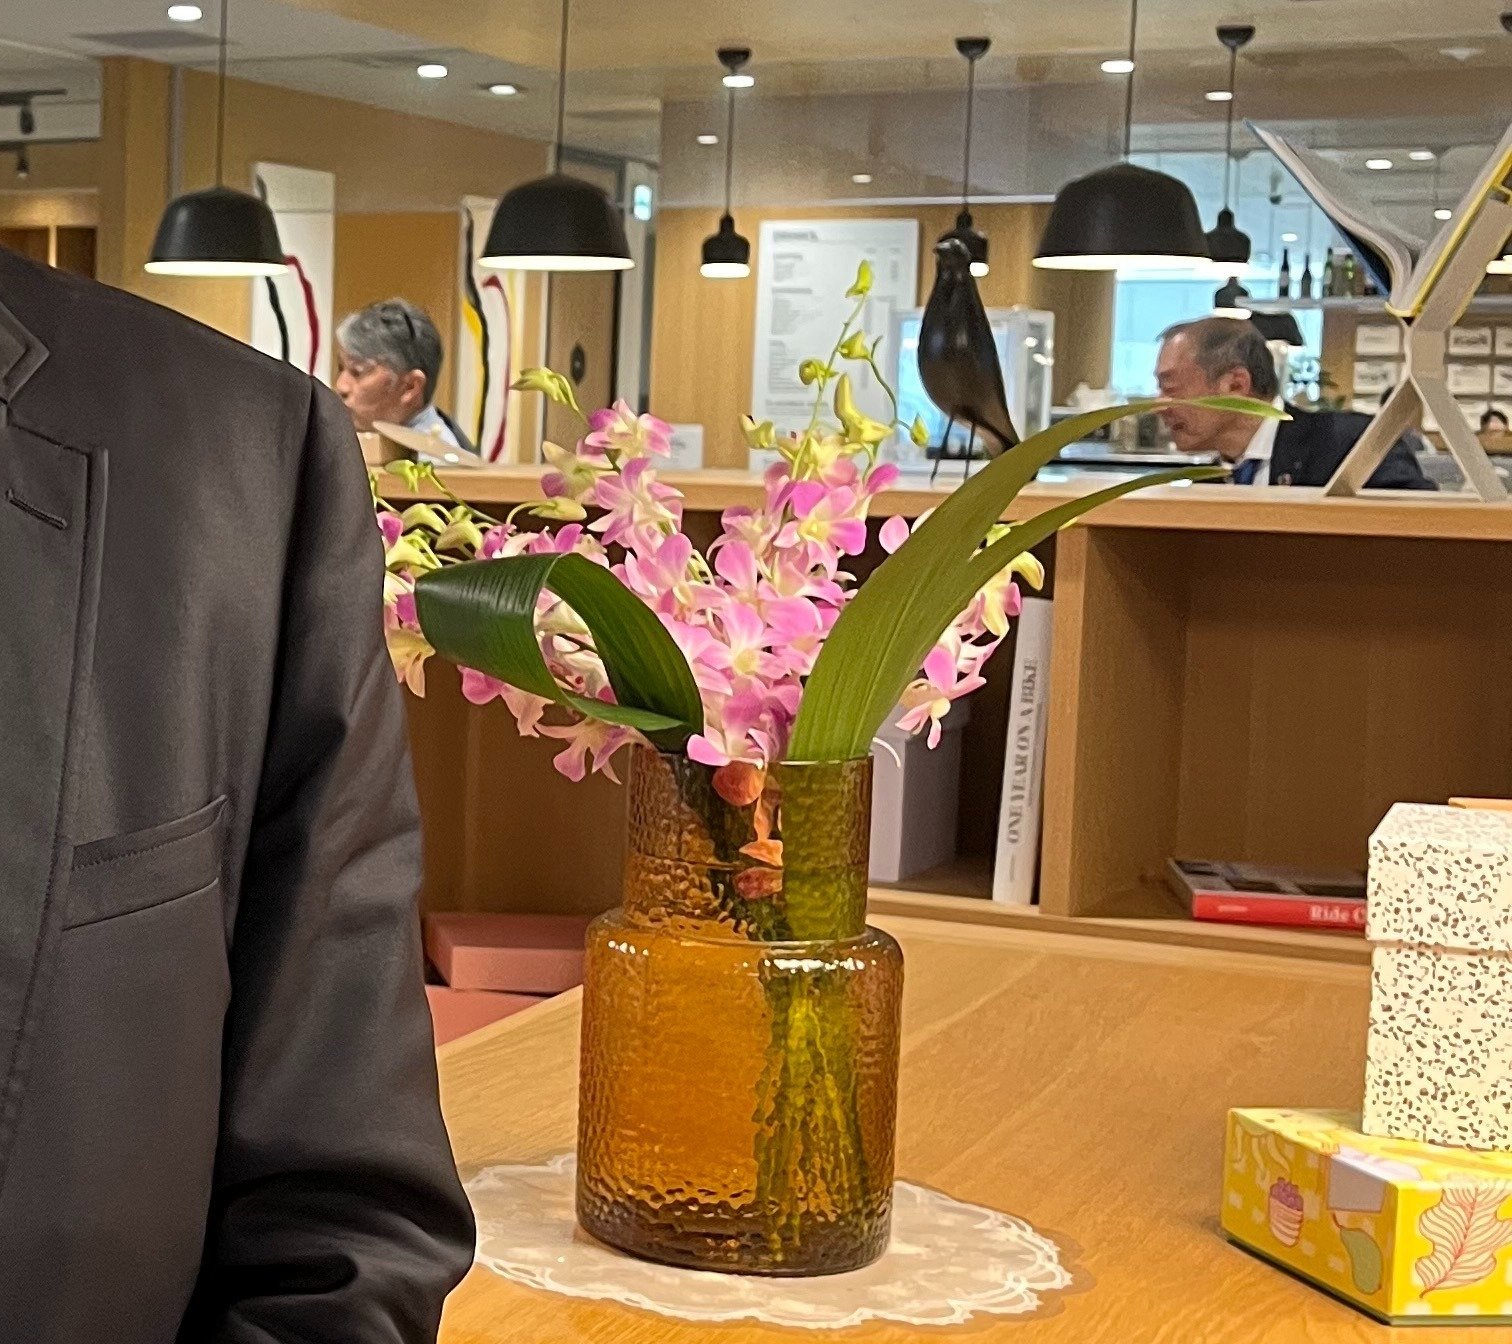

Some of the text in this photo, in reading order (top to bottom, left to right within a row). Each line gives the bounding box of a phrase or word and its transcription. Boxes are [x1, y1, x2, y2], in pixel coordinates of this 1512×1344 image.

[1020, 658, 1038, 704] BIKE
[1016, 724, 1032, 751] ON
[1008, 754, 1029, 803] YEAR
[1006, 806, 1024, 845] ONE
[1308, 905, 1350, 923] Ride
